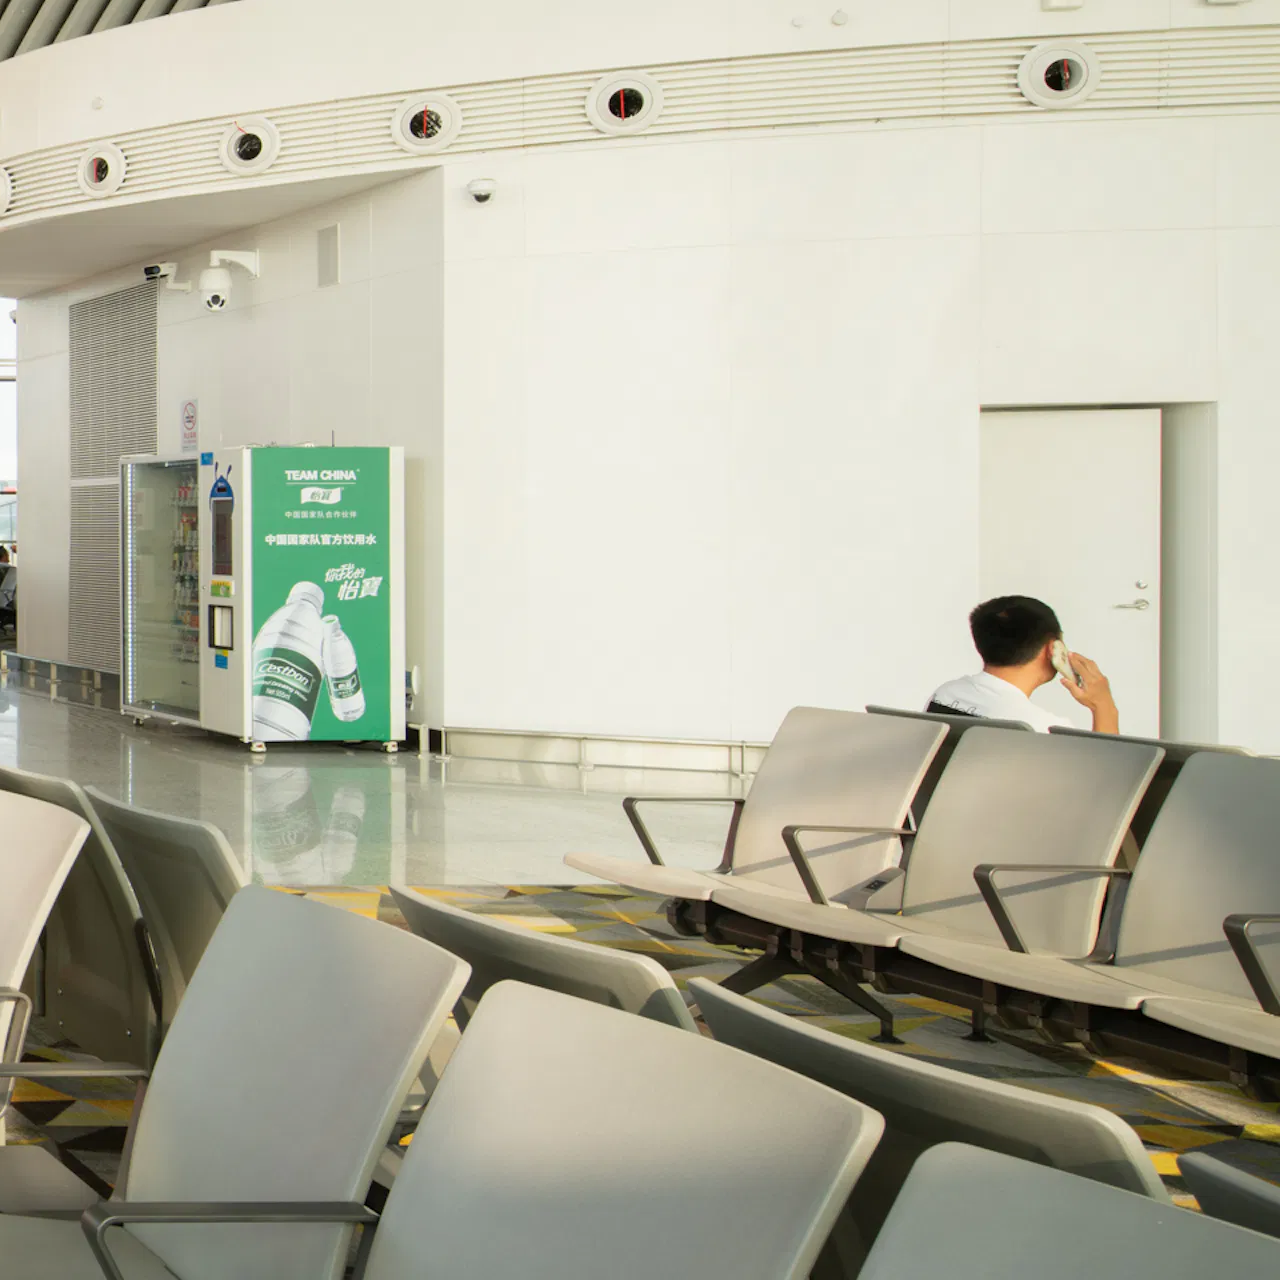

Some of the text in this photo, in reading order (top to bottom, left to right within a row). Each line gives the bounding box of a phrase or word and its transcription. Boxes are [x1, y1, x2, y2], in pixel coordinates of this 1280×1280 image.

[284, 470, 357, 481] TEAM CHINA
[264, 532, 378, 546] 中国国家队官方饮用水
